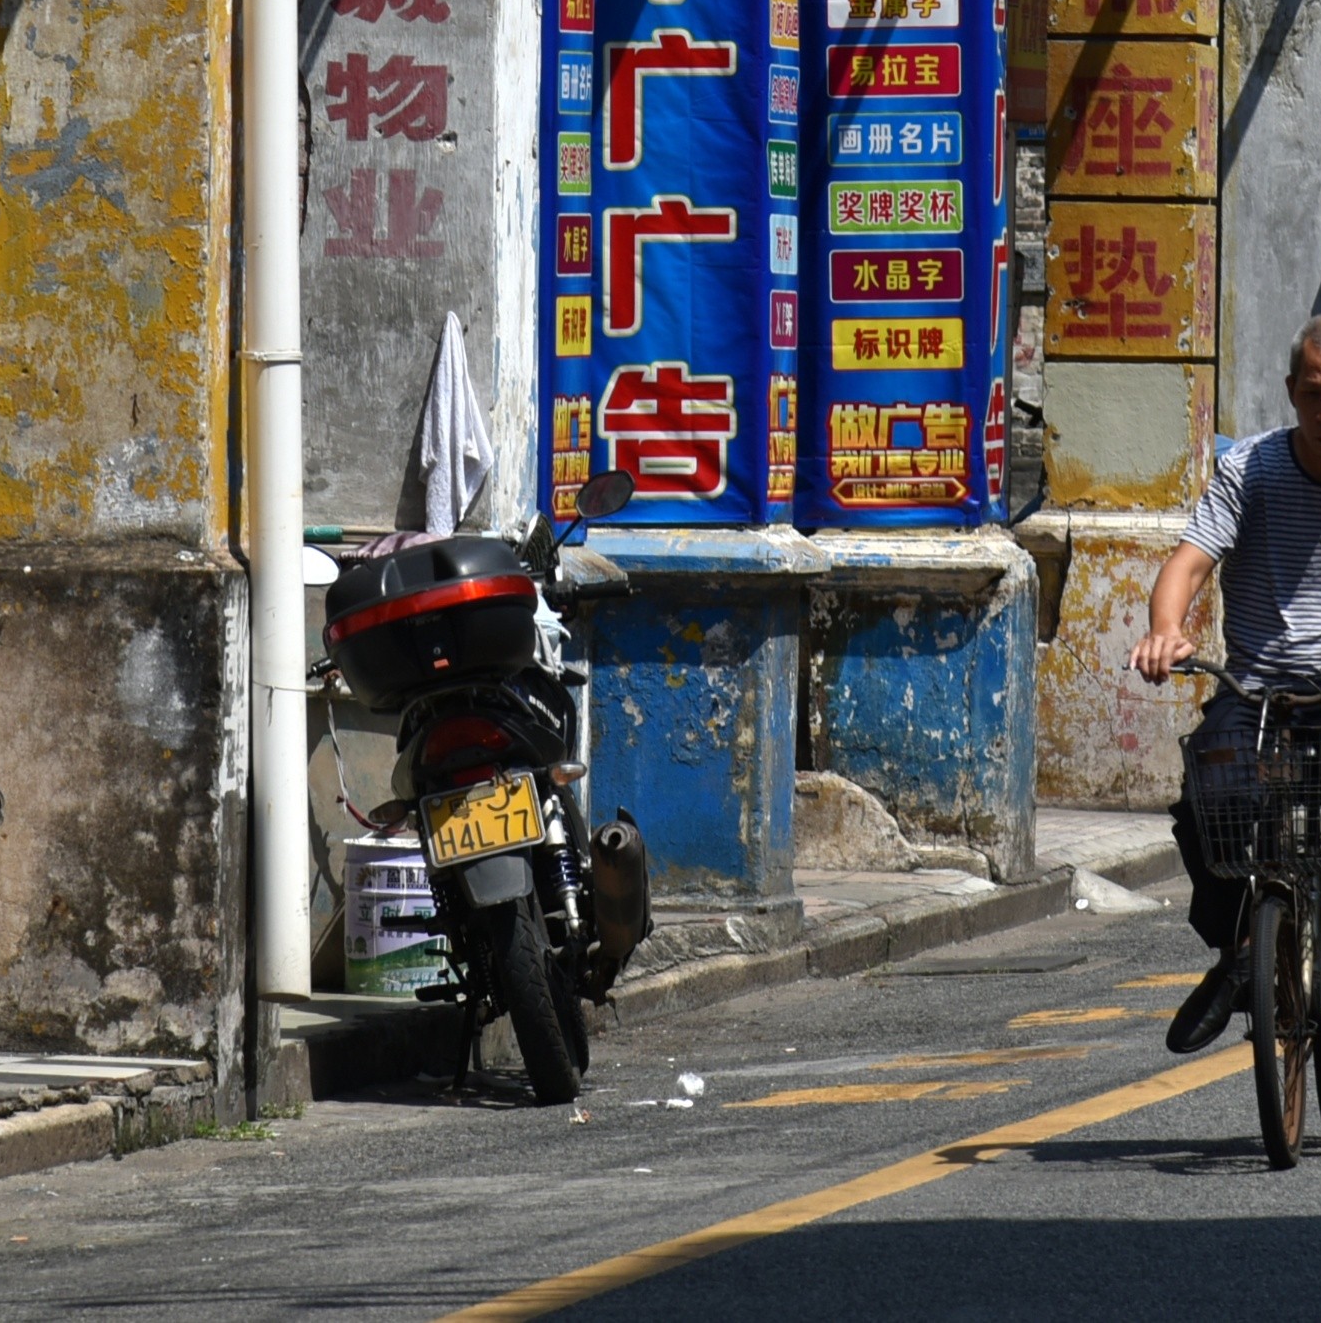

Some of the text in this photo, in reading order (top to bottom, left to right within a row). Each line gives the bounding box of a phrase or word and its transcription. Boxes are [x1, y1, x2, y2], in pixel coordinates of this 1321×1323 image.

[561, 64, 592, 101] 画册名片
[849, 54, 941, 87] 易拉宝
[837, 122, 955, 155] 画册名片
[836, 189, 957, 225] 奖牌奖杯
[563, 225, 589, 263] 水晶字
[852, 258, 944, 292] 水晶字
[561, 306, 588, 346] 标识牌
[852, 327, 945, 361] 标识牌
[830, 403, 968, 449] 做广告
[830, 449, 966, 478] 我们更专业
[441, 808, 531, 858] H4L77
